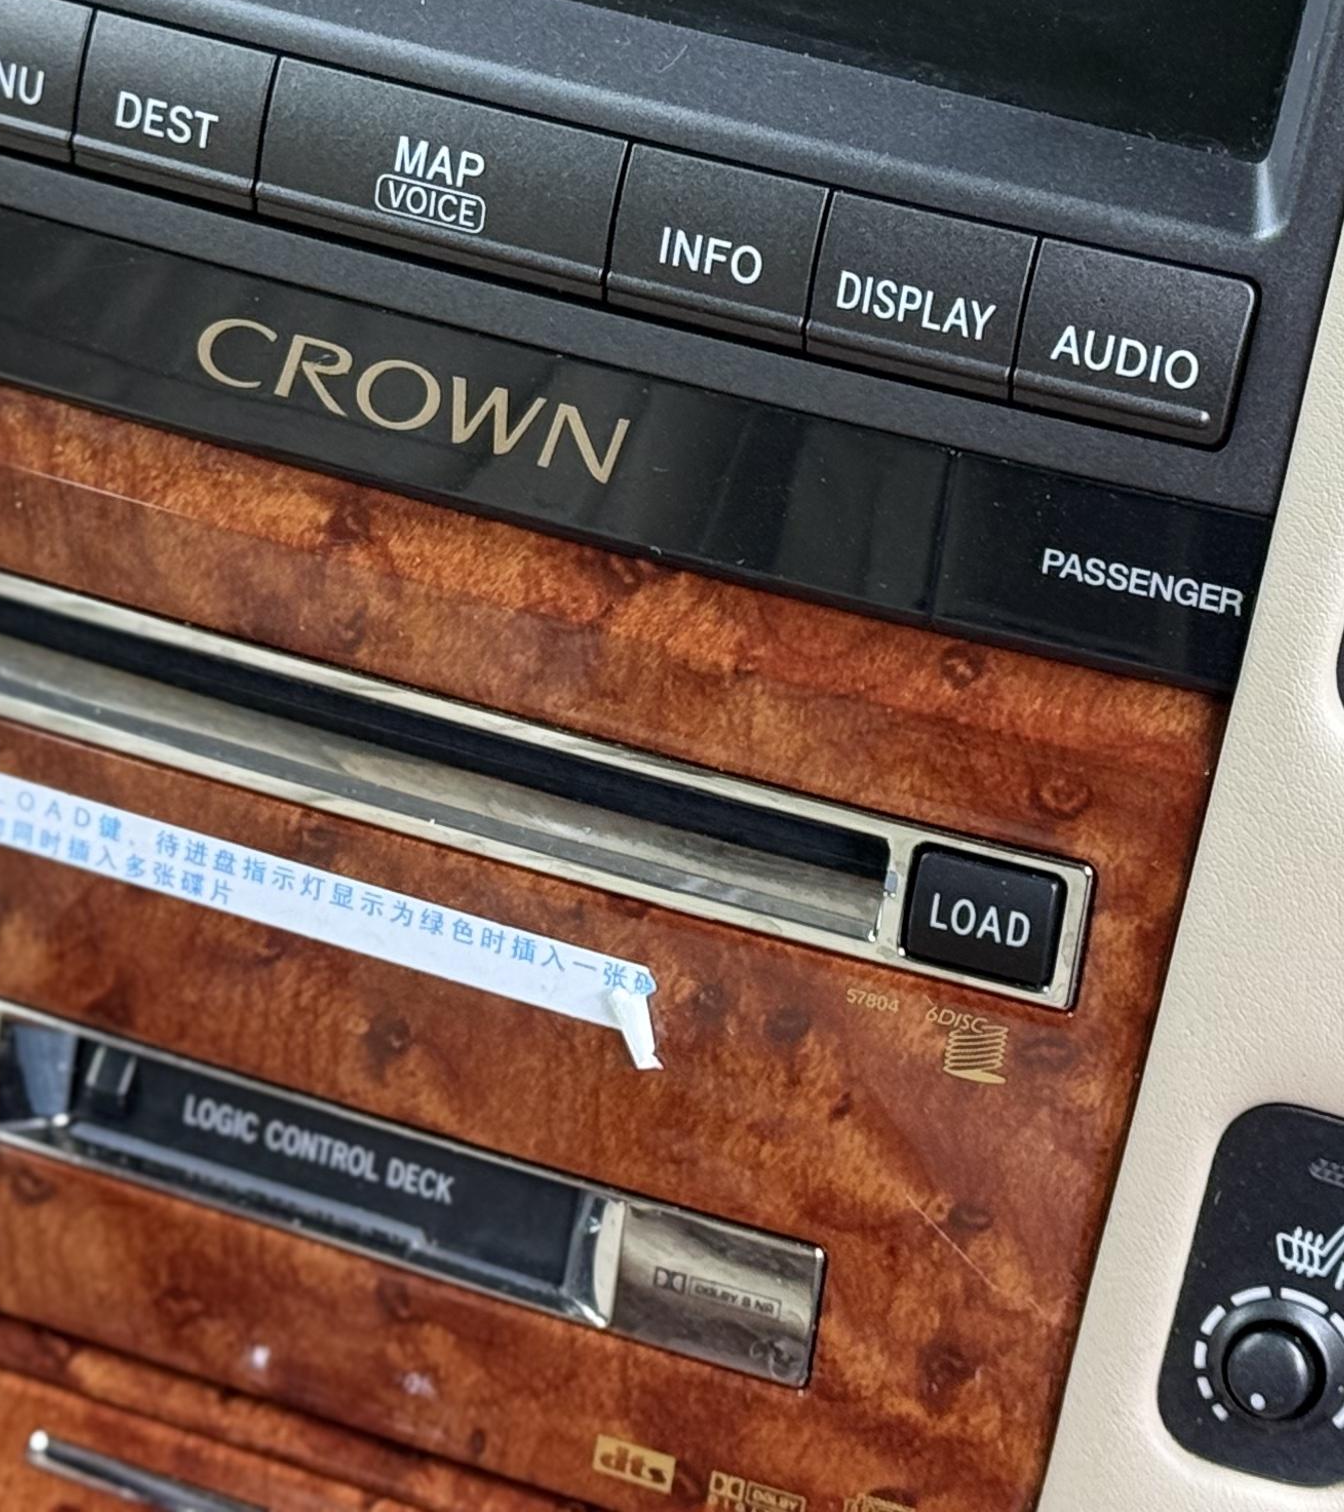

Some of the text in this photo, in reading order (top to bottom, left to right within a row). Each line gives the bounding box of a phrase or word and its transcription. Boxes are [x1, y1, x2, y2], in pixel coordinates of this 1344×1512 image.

[114, 90, 219, 150] DEST
[393, 135, 486, 189] MAP
[386, 180, 478, 229] VOICE
[658, 225, 763, 285] INFO
[835, 269, 997, 342] DISPLAY
[1050, 324, 1200, 391] AUDIO
[196, 317, 631, 485] CROWN
[1040, 547, 1245, 618] PASSENGER
[927, 891, 1031, 949] LOAD
[845, 987, 900, 1015] 57804
[925, 1005, 989, 1035] 6DISC
[182, 1093, 456, 1206] LOGIC CONTROL DECK
[598, 1444, 670, 1487] dts
